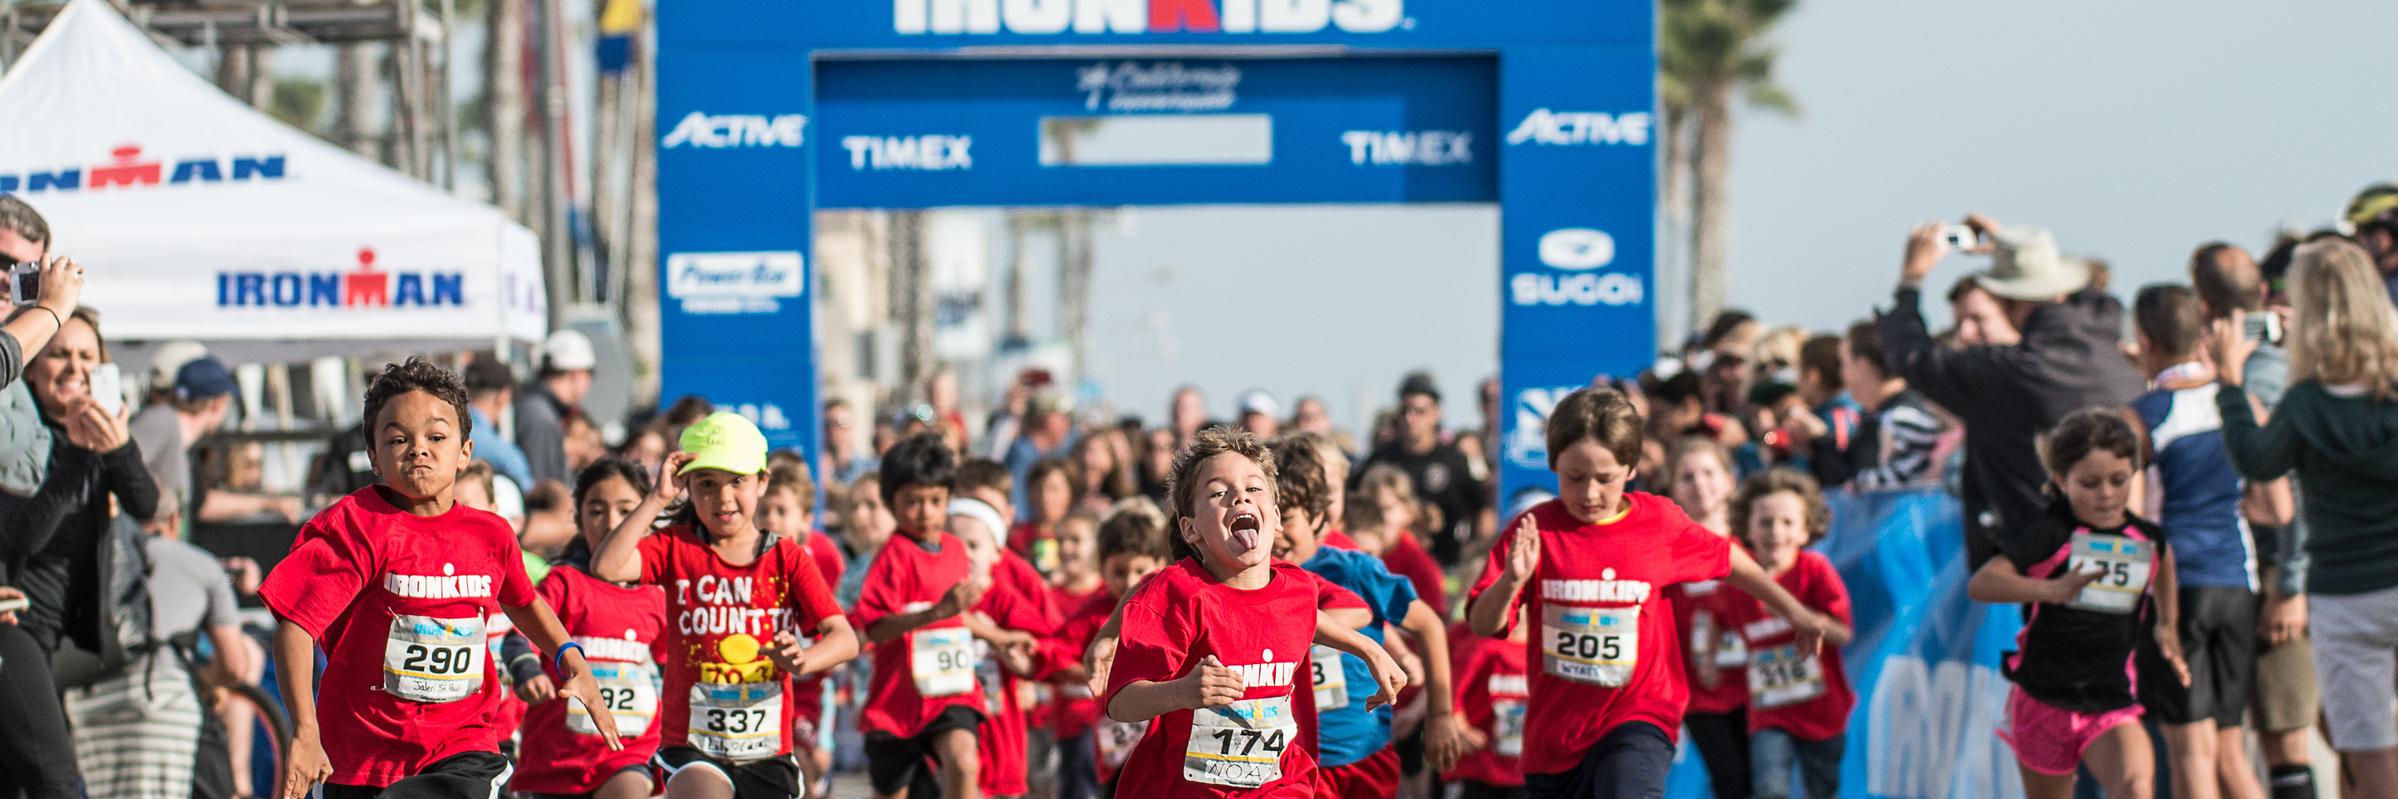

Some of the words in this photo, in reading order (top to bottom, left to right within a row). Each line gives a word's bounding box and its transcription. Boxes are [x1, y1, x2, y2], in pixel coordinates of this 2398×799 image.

[662, 112, 808, 149] ACTIVE
[1506, 108, 1652, 146] ACTIVE
[842, 135, 971, 170] TIMEX
[1341, 131, 1472, 165] TIMEX
[216, 248, 462, 307] IRONMAN
[384, 562, 492, 598] IRONKIDS
[676, 579, 690, 605] I
[697, 575, 753, 605] CAN
[679, 606, 765, 635] COUNT
[403, 644, 471, 674] 290
[1557, 632, 1620, 659] 205
[938, 651, 969, 671] 90
[707, 709, 766, 733] 337
[1213, 728, 1285, 757] 174
